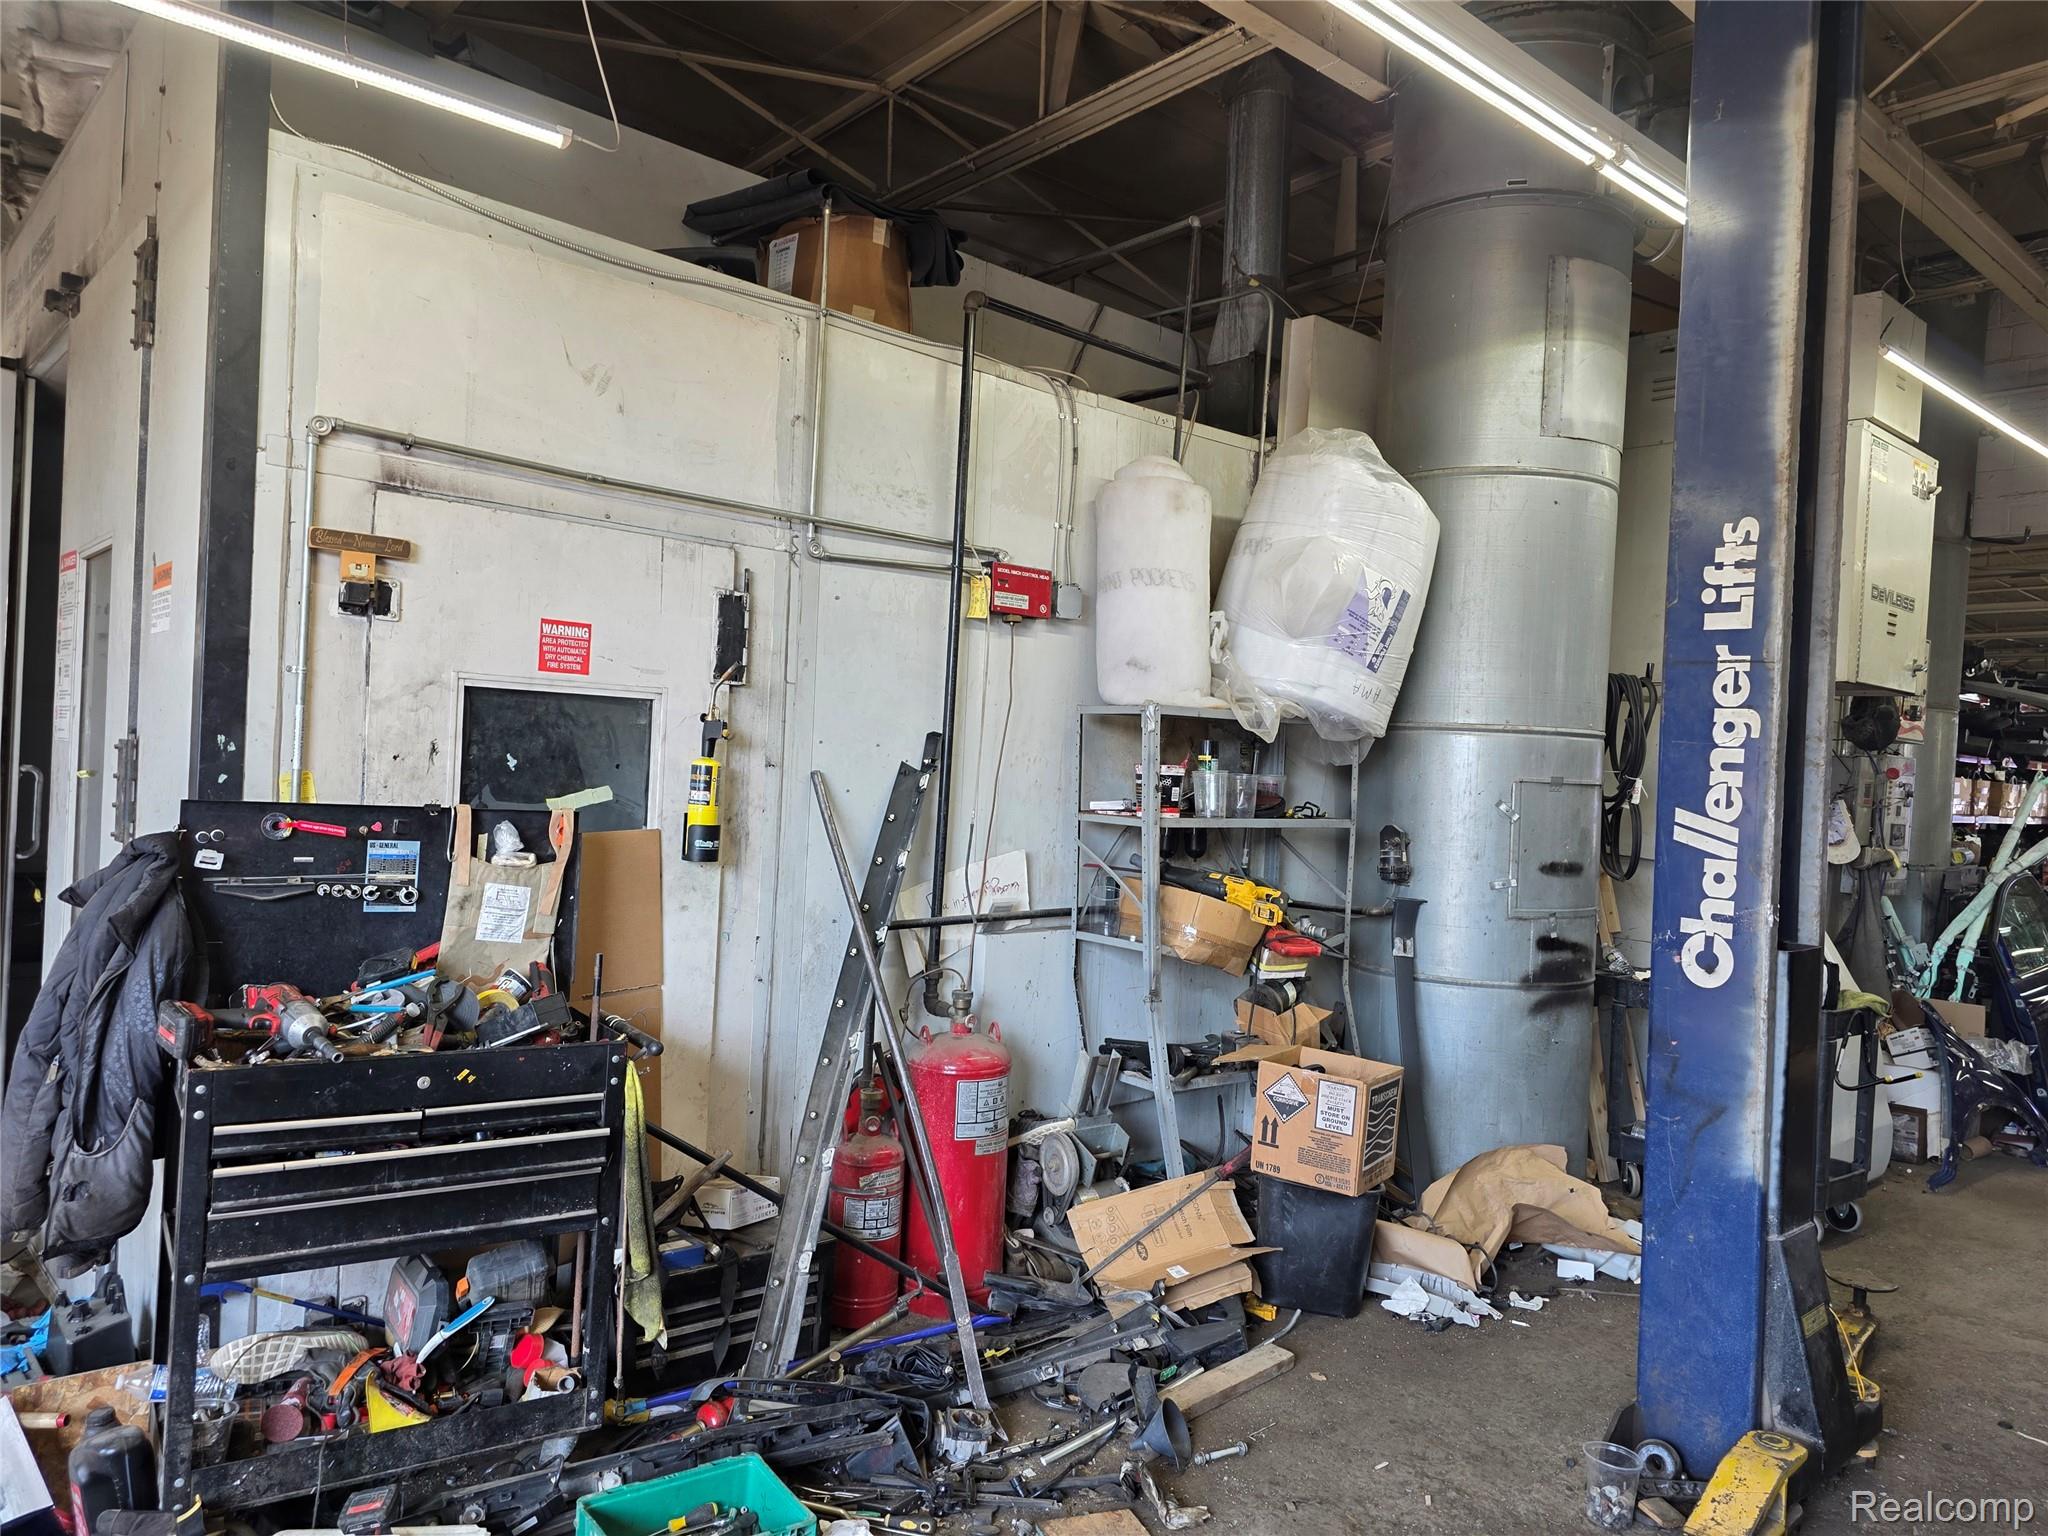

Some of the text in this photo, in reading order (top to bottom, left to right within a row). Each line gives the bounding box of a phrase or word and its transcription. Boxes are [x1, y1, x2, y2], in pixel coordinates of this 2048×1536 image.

[315, 529, 345, 545] Blessed
[384, 539, 404, 552] Lord
[542, 623, 589, 638] WARNING
[557, 639, 588, 648] PROTECTED
[557, 646, 587, 655] AUTOMATIC
[557, 655, 583, 663] CHEMICAL
[1673, 515, 1762, 989] Challenger Lifts
[1272, 1095, 1299, 1107] CORROSIVE
[1327, 1105, 1344, 1113] MUST
[1320, 1110, 1339, 1119] STORE
[1321, 1117, 1348, 1126] GROUND
[1255, 1160, 1281, 1174] UN 1789
